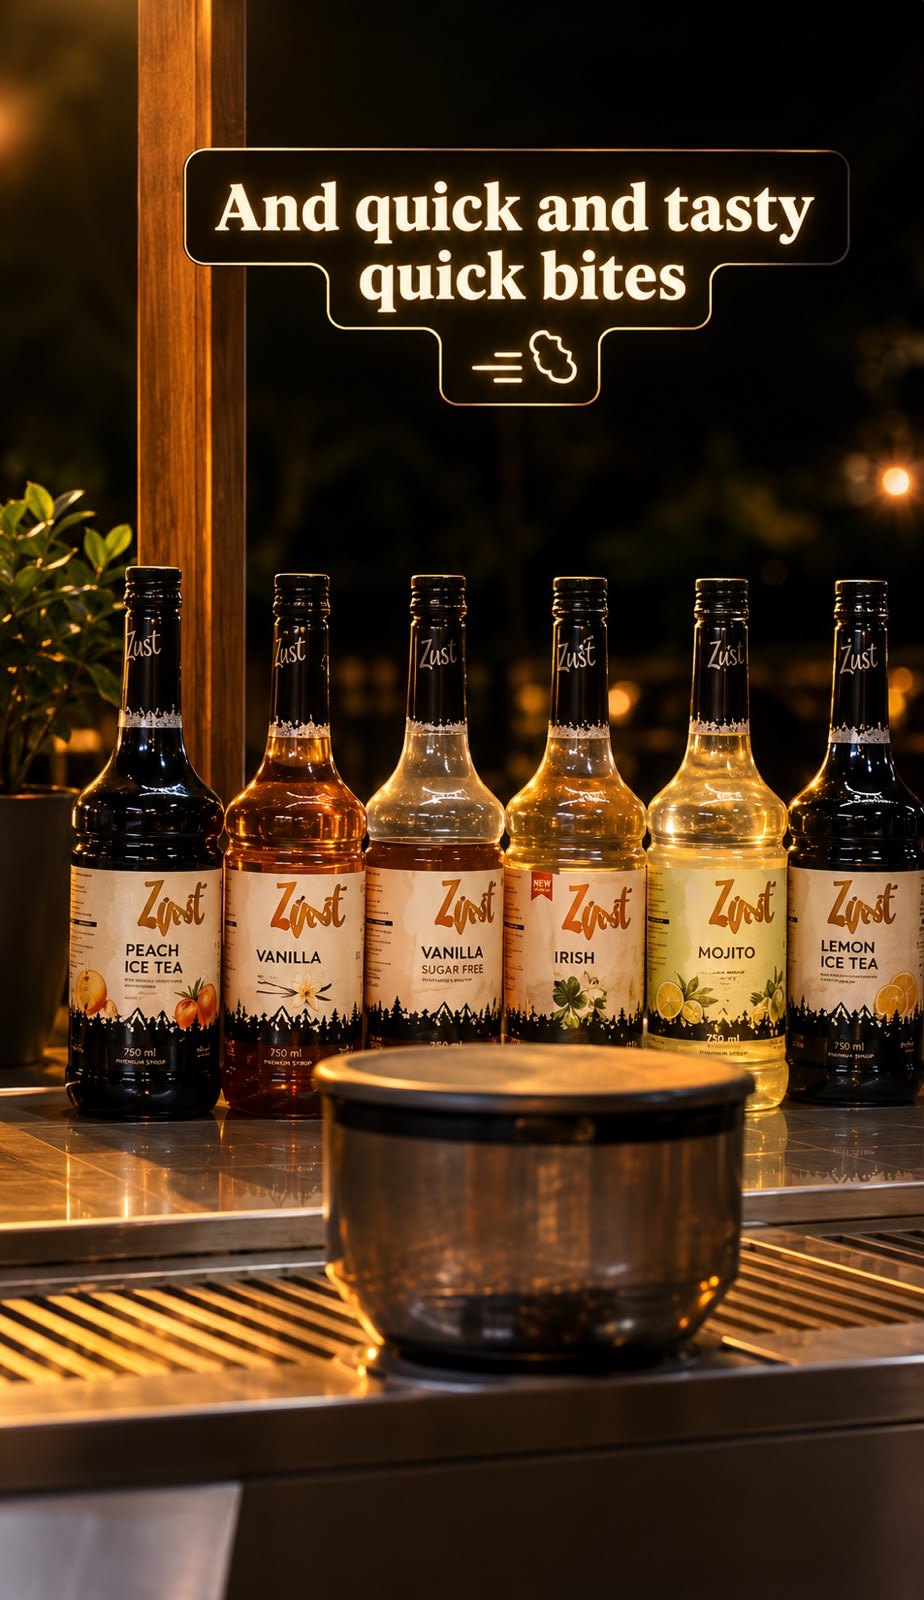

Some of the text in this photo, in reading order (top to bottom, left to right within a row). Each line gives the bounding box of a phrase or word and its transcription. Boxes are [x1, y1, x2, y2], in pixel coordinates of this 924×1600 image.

[214, 181, 814, 244] And quick and tasty
[359, 250, 686, 313] quick bites
[420, 638, 457, 670] Zust
[534, 879, 551, 888] NEW
[126, 944, 179, 957] PEACH
[421, 946, 484, 960] VANILLA
[698, 946, 755, 960] MOJITO
[821, 940, 875, 954] LEMON
[256, 949, 321, 964] VANILLA
[554, 951, 595, 964] IRISH
[821, 956, 879, 970] ICE TEA
[125, 960, 183, 974] ICE TEA
[421, 964, 484, 975] SUGAR FREE
[706, 1033, 740, 1043] 750 ml
[123, 1047, 157, 1057] 750 ml
[270, 1048, 302, 1058] 750 ml
[834, 1041, 864, 1051] 750 ml
